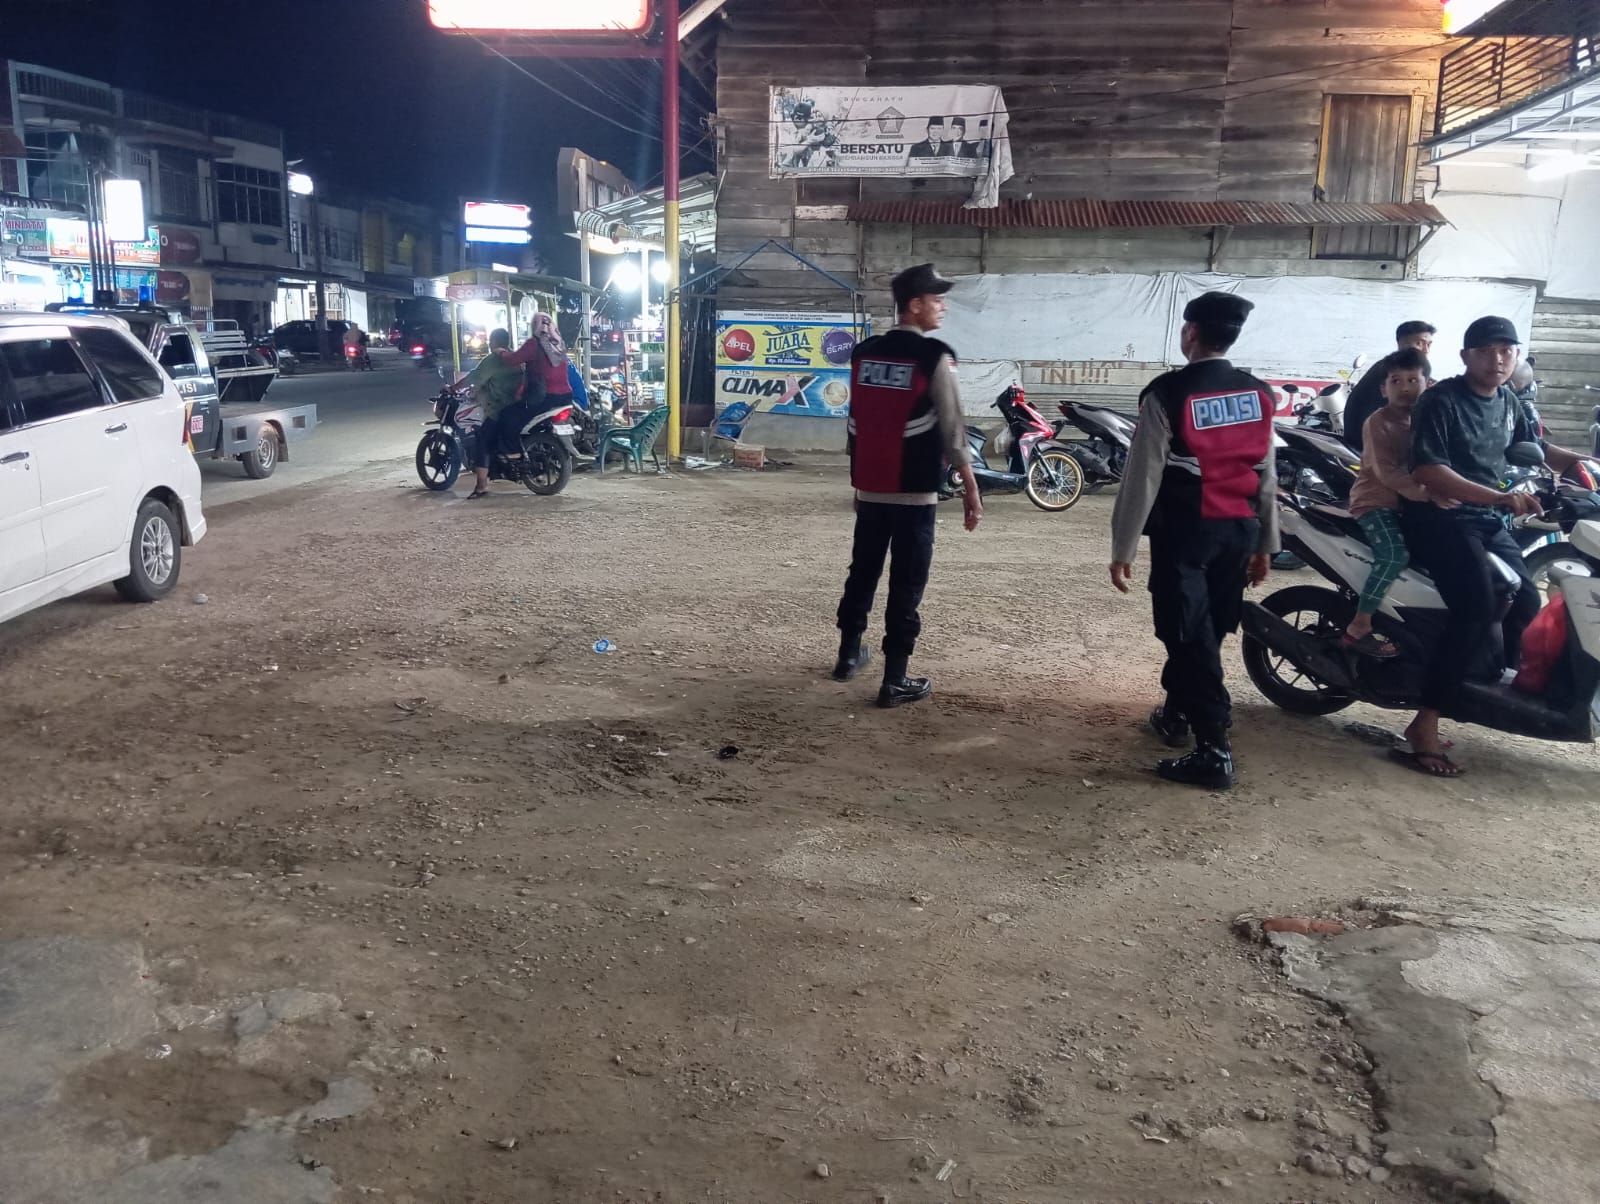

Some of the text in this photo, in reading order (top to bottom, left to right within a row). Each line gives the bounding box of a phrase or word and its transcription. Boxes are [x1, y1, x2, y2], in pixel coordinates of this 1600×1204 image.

[840, 143, 904, 154] BERSATU
[725, 337, 752, 353] APEL
[766, 331, 811, 354] JUARA
[826, 341, 853, 354] BERRY
[857, 362, 914, 388] POLISI
[722, 374, 820, 409] CLIMAX
[1194, 394, 1260, 428] POLISI
